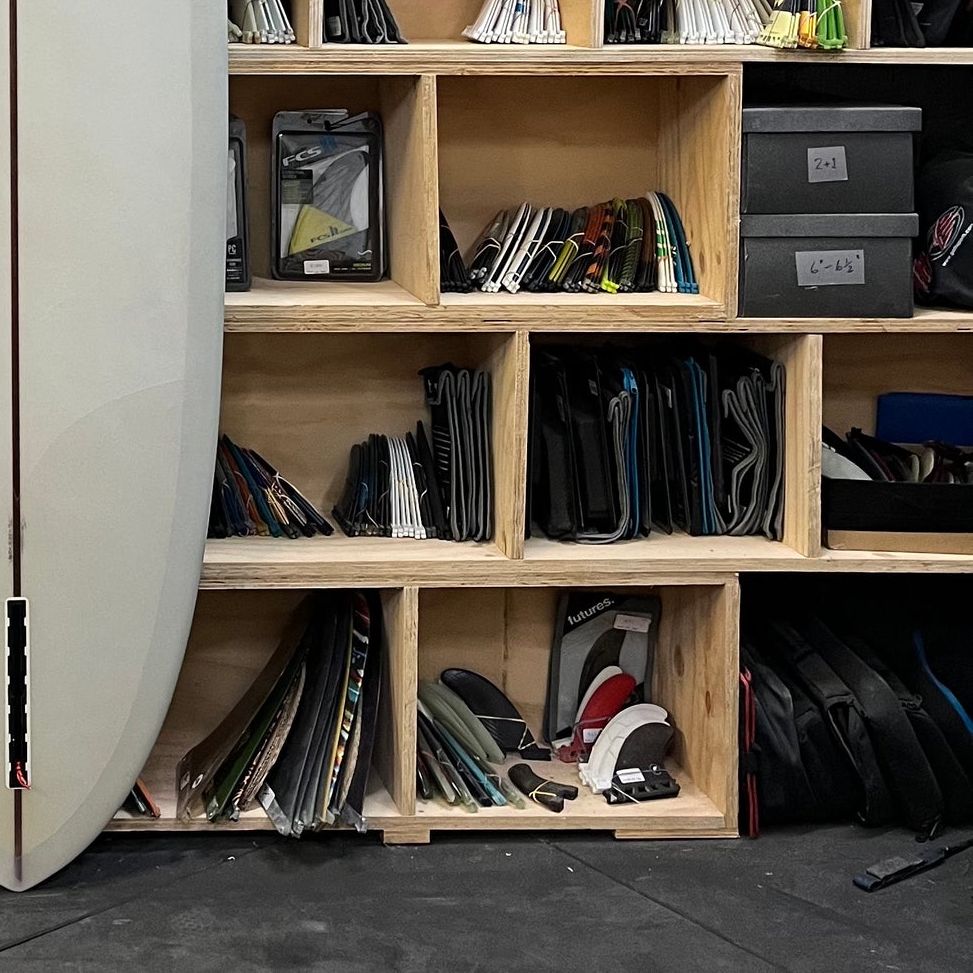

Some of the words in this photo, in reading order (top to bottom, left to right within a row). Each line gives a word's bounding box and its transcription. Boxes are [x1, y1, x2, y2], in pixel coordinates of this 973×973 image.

[282, 145, 322, 167] FCS
[814, 157, 837, 170] 2+1
[567, 596, 615, 626] futures.
